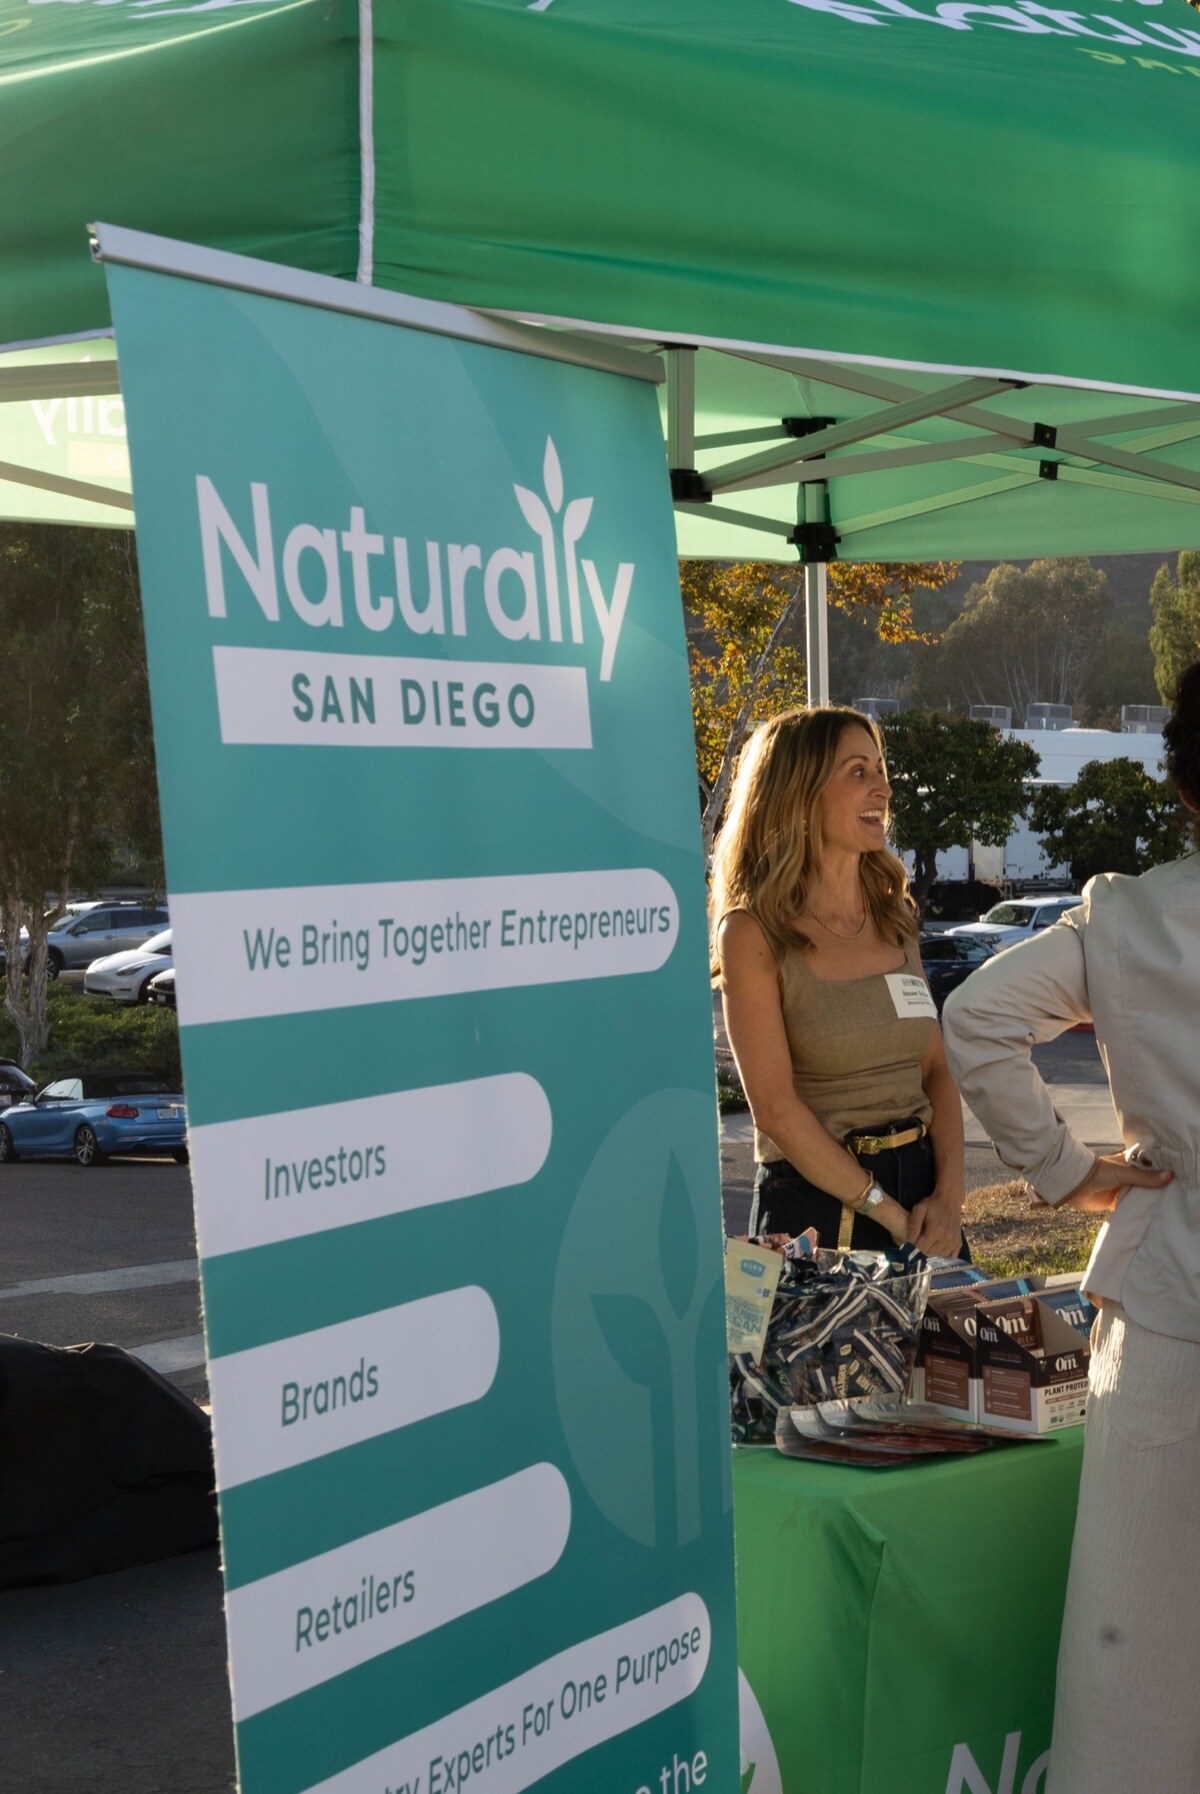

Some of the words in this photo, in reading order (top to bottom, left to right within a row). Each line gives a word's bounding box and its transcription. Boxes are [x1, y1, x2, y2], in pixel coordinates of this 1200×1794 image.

[196, 475, 635, 682] Naturally
[290, 672, 375, 725] SAN
[401, 680, 536, 728] DIEGO
[244, 928, 290, 970] We
[303, 920, 369, 971] Bring
[379, 912, 491, 965] Together
[501, 906, 670, 950] Entrepreneurs
[266, 1145, 385, 1200] Investors
[728, 1312, 763, 1335] EGAN
[923, 1316, 941, 1333] Om
[979, 1327, 999, 1343] Om
[995, 1314, 1029, 1335] Om
[1045, 1386, 1064, 1396] PLANT
[1066, 1380, 1089, 1392] PROTEIN
[1055, 1357, 1078, 1372] Om
[282, 1358, 378, 1426] Brands
[294, 1568, 417, 1654] Retailers
[428, 1723, 516, 1794] Experts
[523, 1700, 554, 1746] For
[561, 1674, 607, 1719] One
[614, 1624, 702, 1695] Purpose
[660, 1751, 707, 1794] the
